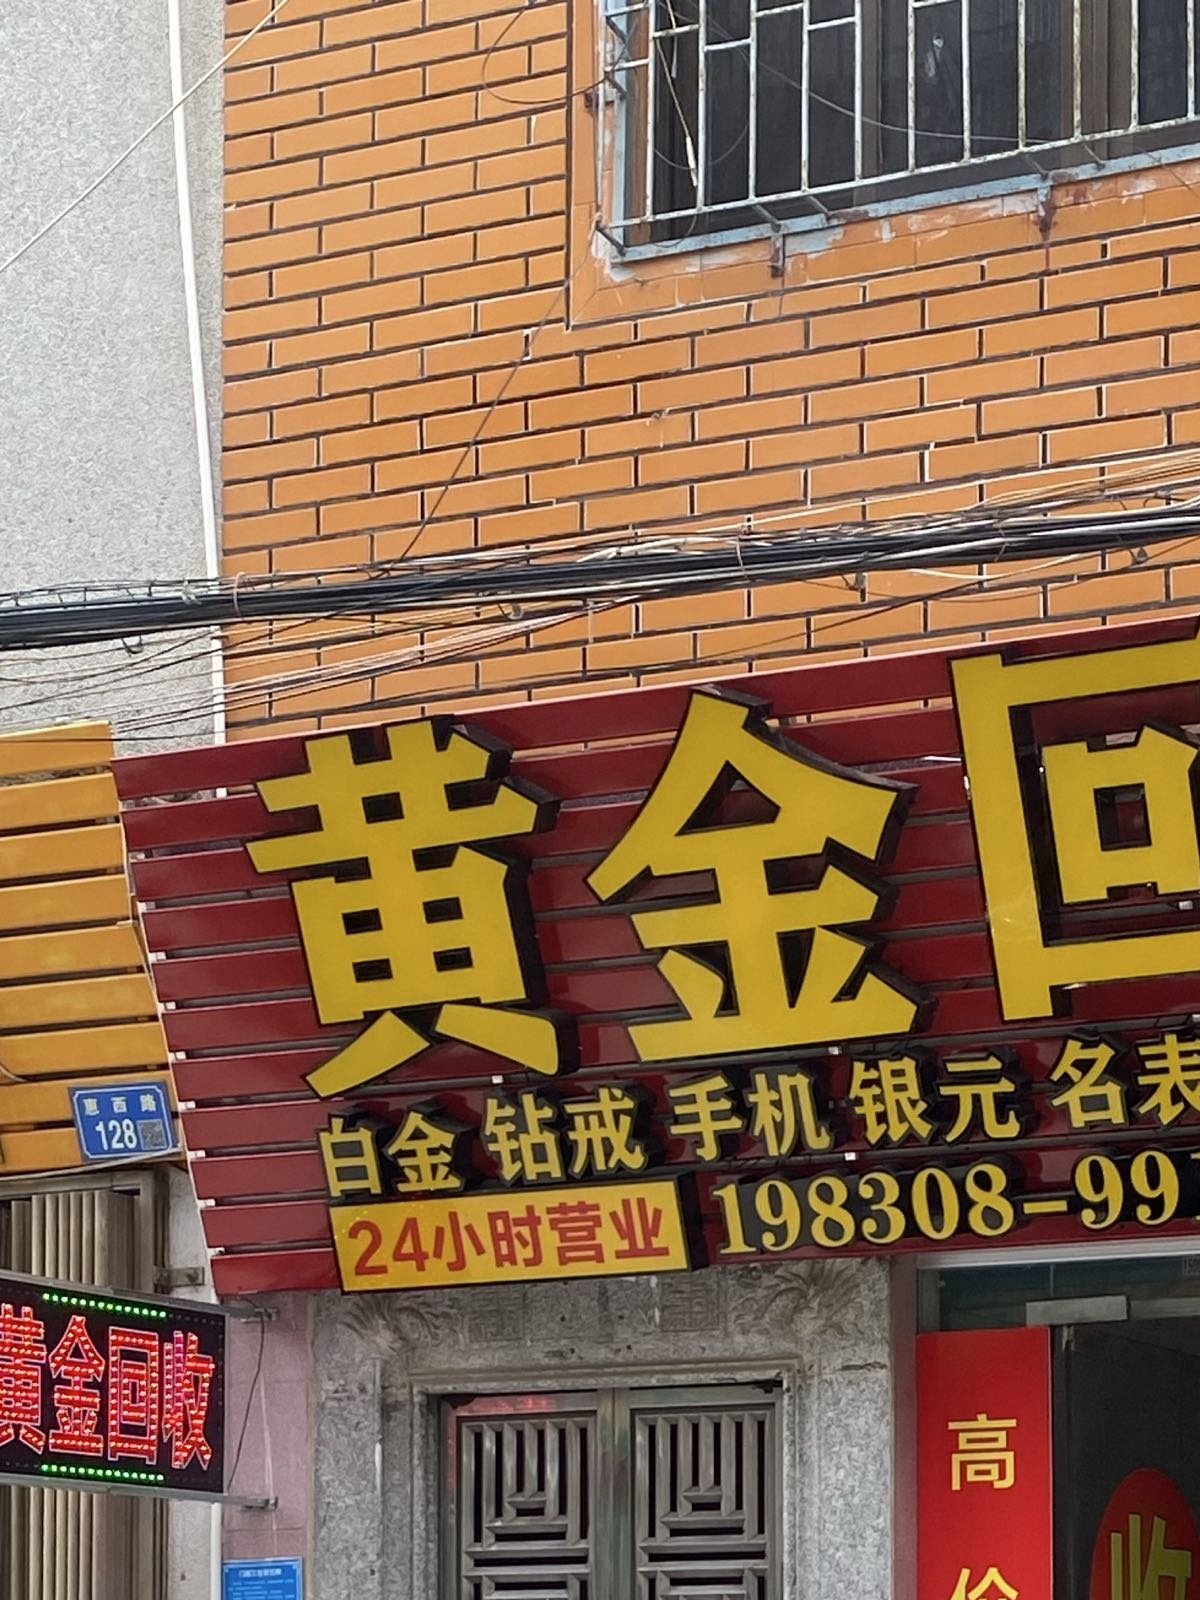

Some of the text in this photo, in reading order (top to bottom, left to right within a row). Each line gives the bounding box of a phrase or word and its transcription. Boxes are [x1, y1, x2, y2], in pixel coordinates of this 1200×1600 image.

[96, 1119, 138, 1151] 128
[319, 1113, 462, 1196] 白金
[485, 1087, 646, 1182] 钻戒
[669, 1074, 831, 1160] 手机
[850, 1052, 1021, 1144] 银元
[348, 1197, 670, 1277] 24小时营业
[0, 1303, 215, 1471] 黄金回收
